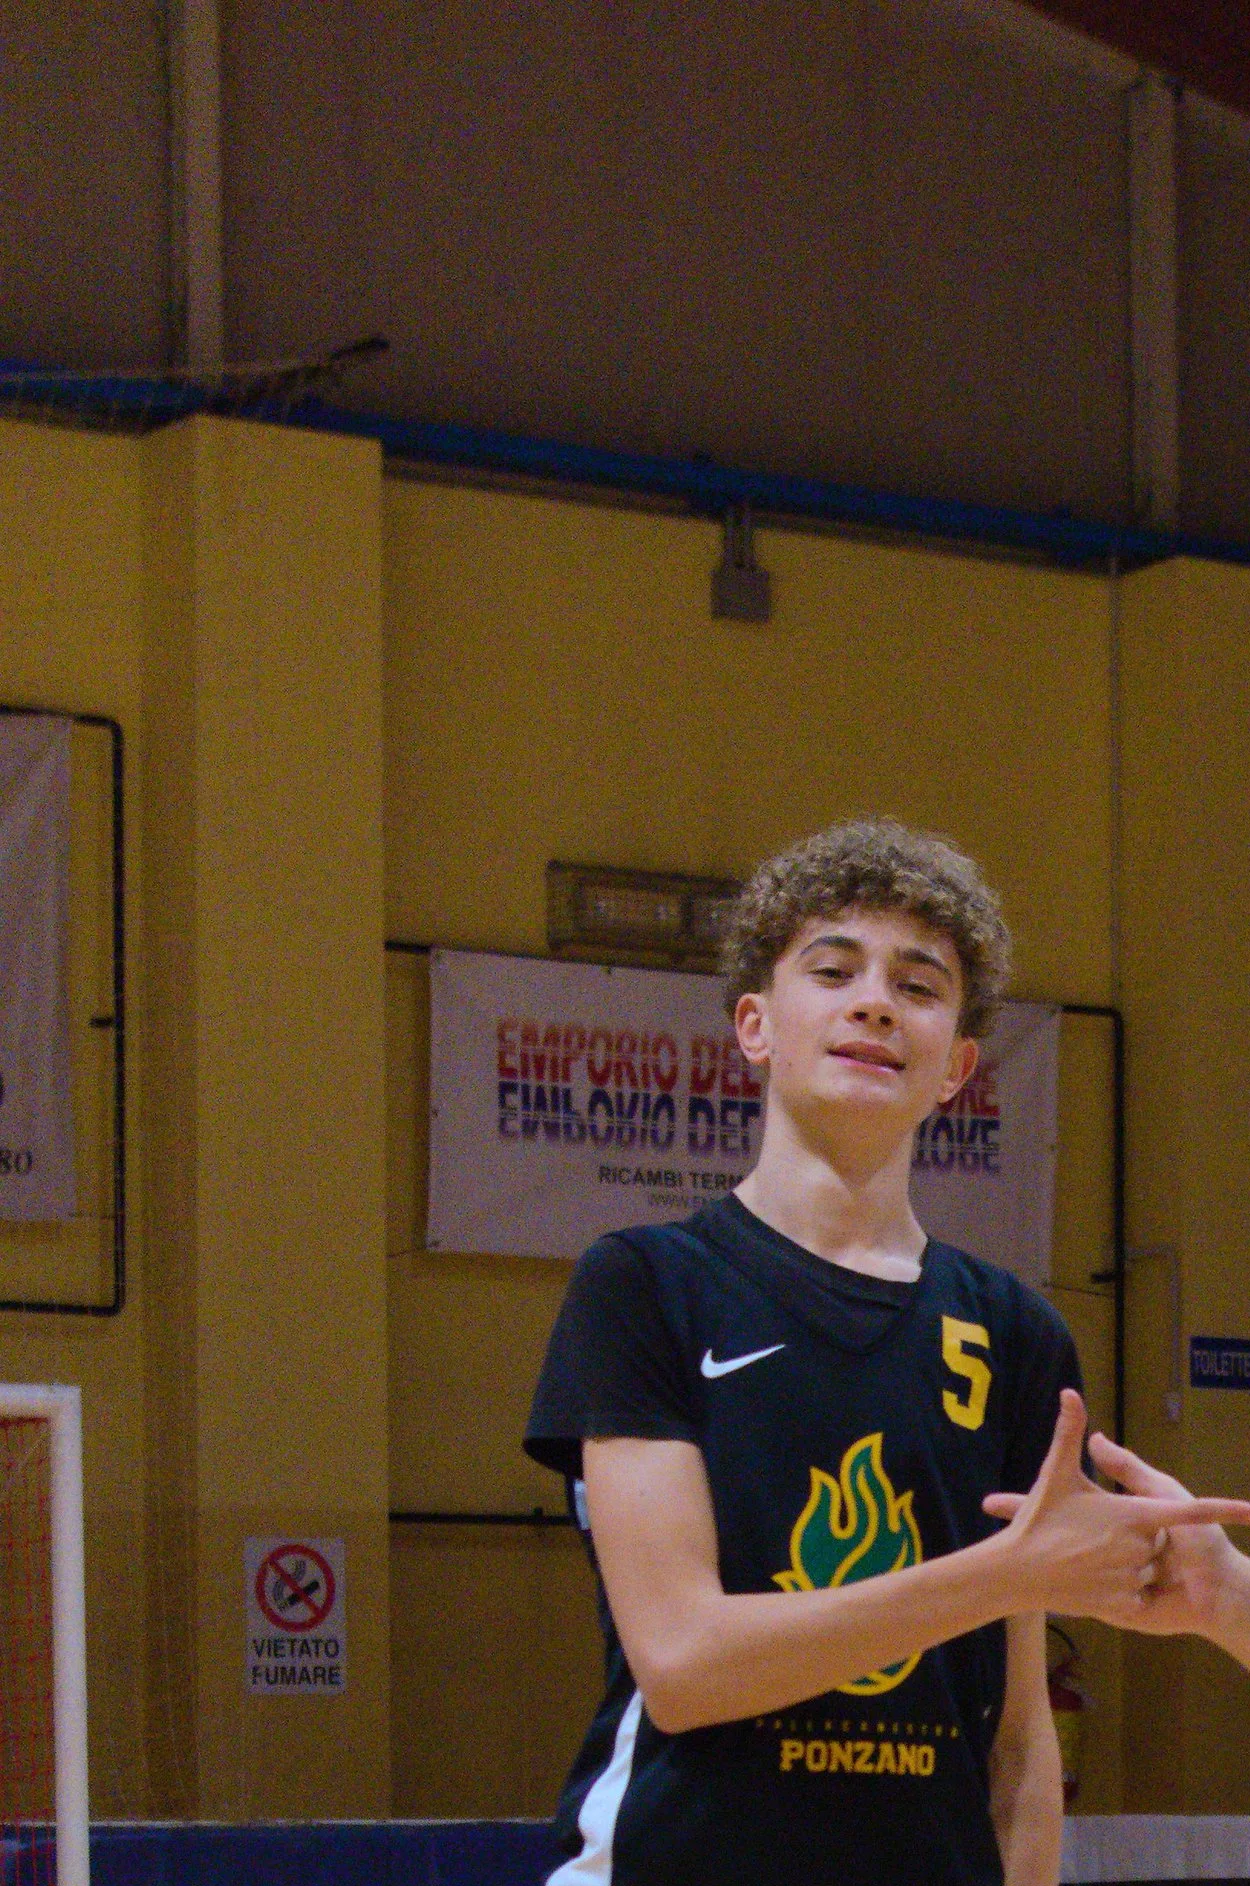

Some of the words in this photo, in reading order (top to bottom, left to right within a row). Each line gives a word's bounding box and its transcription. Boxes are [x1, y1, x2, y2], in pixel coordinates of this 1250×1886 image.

[496, 1018, 678, 1092] EMPORIO
[598, 1164, 682, 1189] RICAMBI
[689, 1171, 743, 1190] TERM
[942, 1315, 992, 1431] 5
[252, 1638, 341, 1659] VIETATO
[251, 1665, 342, 1686] FUMARE
[779, 1738, 937, 1777] PONZANO
